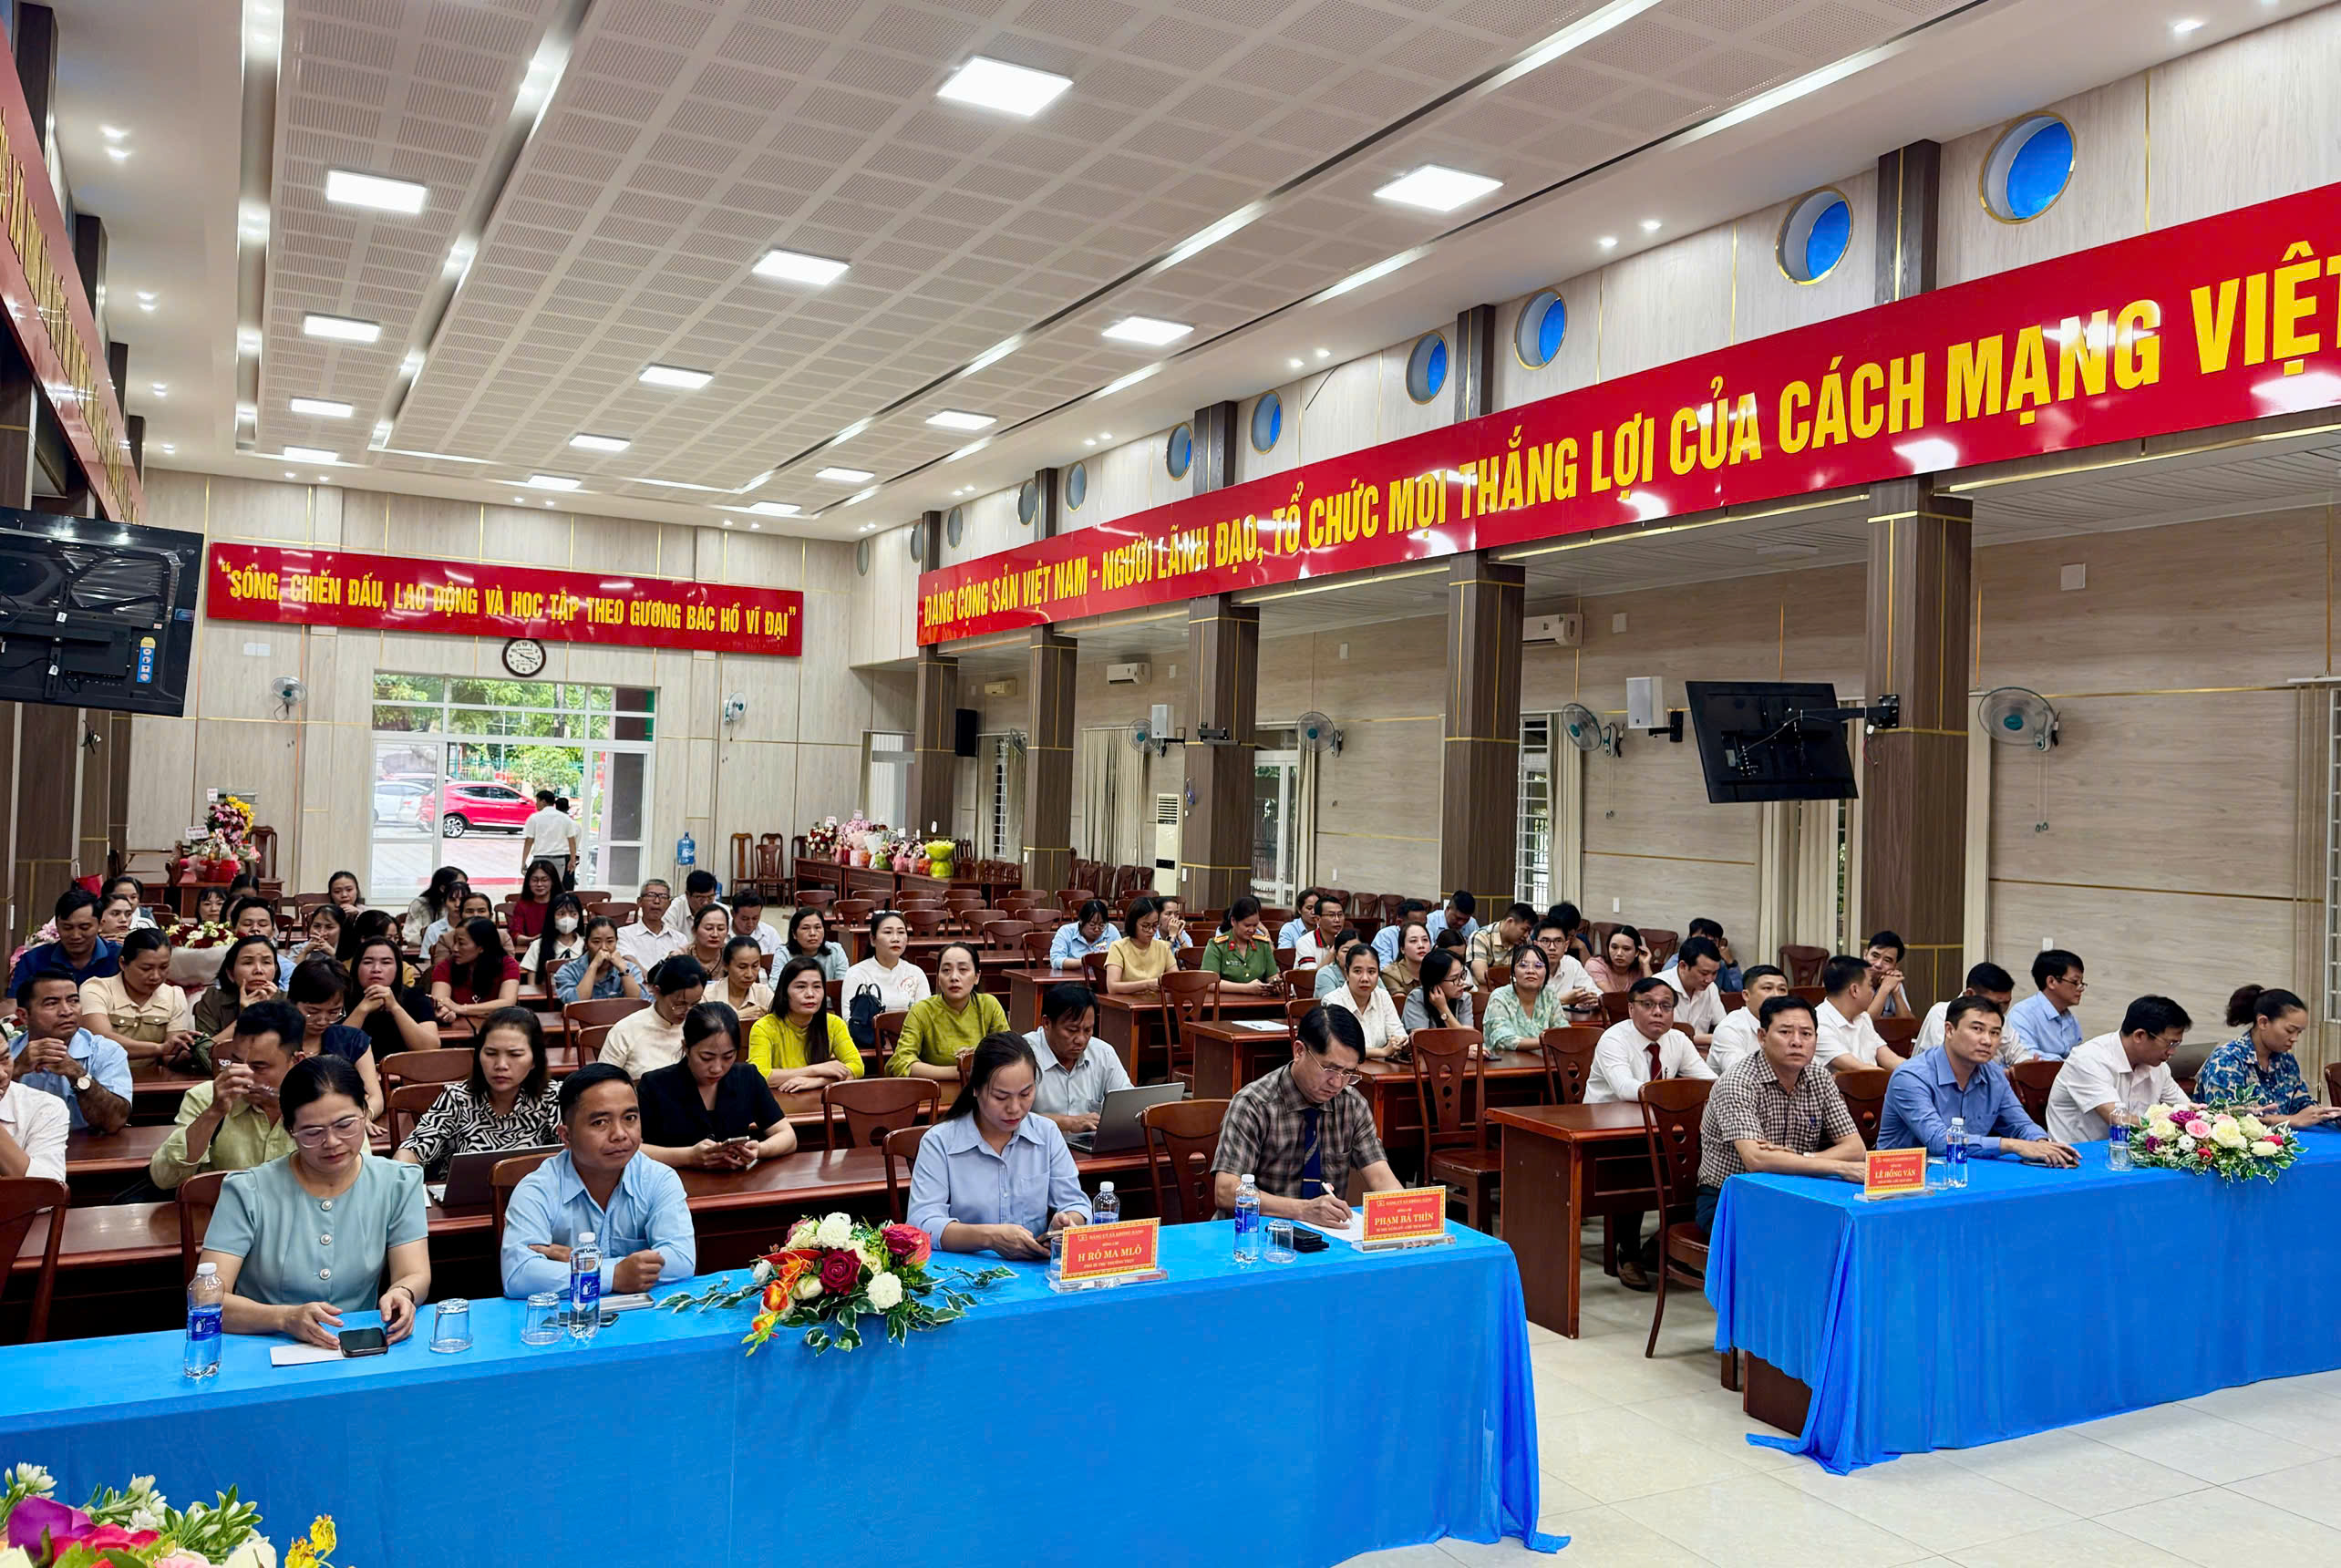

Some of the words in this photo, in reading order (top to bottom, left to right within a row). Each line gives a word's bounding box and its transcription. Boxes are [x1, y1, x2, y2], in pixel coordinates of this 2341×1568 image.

[923, 583, 954, 628] ĐẢNG
[956, 576, 989, 626] CỘNG
[992, 564, 1018, 613] SẢN
[1022, 560, 1051, 612] VIỆT
[1054, 555, 1089, 600] NAM
[1102, 531, 1153, 591] NGƯỜI
[1157, 525, 1209, 579] LÃNH
[1215, 514, 1264, 573] ĐẠO,
[1272, 480, 1304, 555] TỔ
[1308, 479, 1379, 548] CHỨC
[1387, 469, 1448, 539] MỌI
[1459, 425, 1579, 520] THẮNG
[1591, 412, 1655, 500] LỢI
[1669, 376, 1762, 476] CỦA
[1779, 352, 1926, 454] CÁCH
[1945, 299, 2161, 426] MẠNG
[290, 570, 342, 605] CHIẾN
[347, 571, 387, 612] ĐẤU,
[394, 582, 427, 610] LAO
[432, 579, 478, 617] ĐỘNG
[485, 584, 505, 616] VÀ
[510, 591, 543, 624] HỌC
[550, 590, 580, 625] TẬP
[586, 597, 624, 624] THEO
[629, 598, 681, 629] GƯƠNG
[686, 601, 716, 632] BÁC
[720, 602, 740, 634] HỒ
[746, 605, 761, 635] VĨ
[1078, 1253, 1086, 1262] H
[1104, 1249, 1119, 1258] MA
